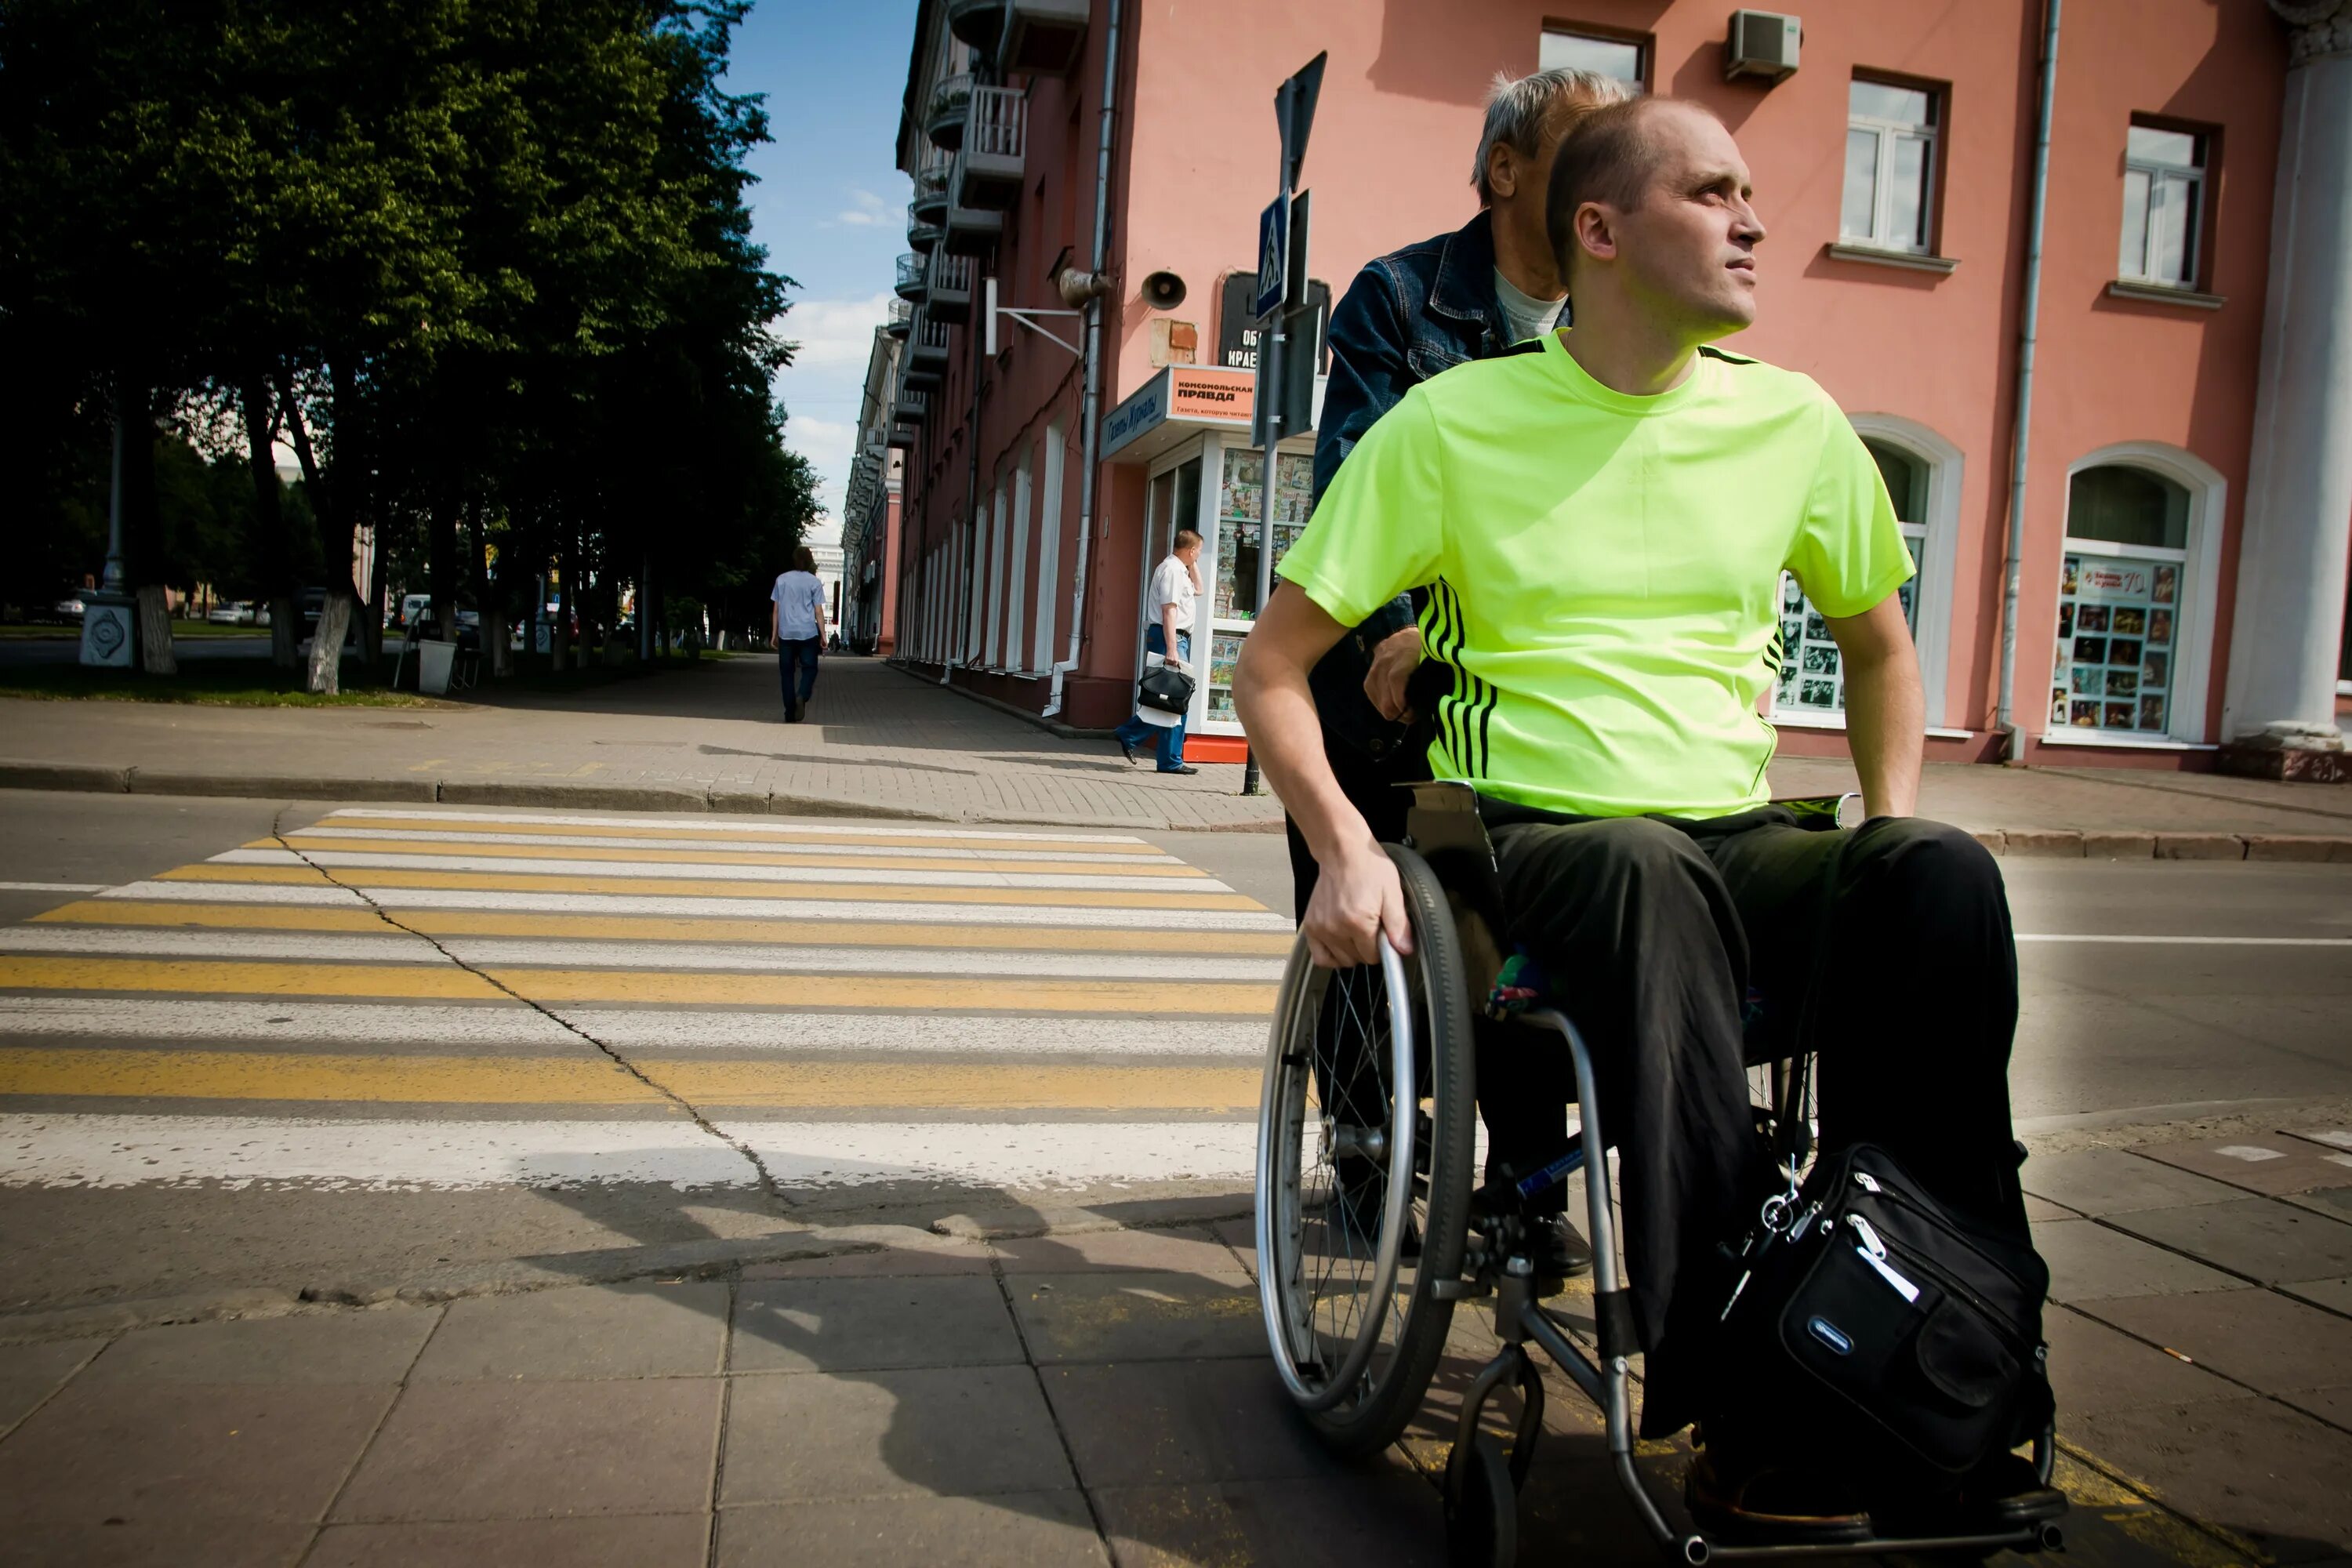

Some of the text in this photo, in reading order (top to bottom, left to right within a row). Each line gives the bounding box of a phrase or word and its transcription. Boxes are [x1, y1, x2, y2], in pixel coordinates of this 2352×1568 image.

[1243, 329, 1261, 347] ОБ
[1178, 381, 1253, 393] КОМСОМОЛЬСКАЯ
[1178, 389, 1235, 401] ПРАВДА
[1177, 406, 1200, 415] Газета,
